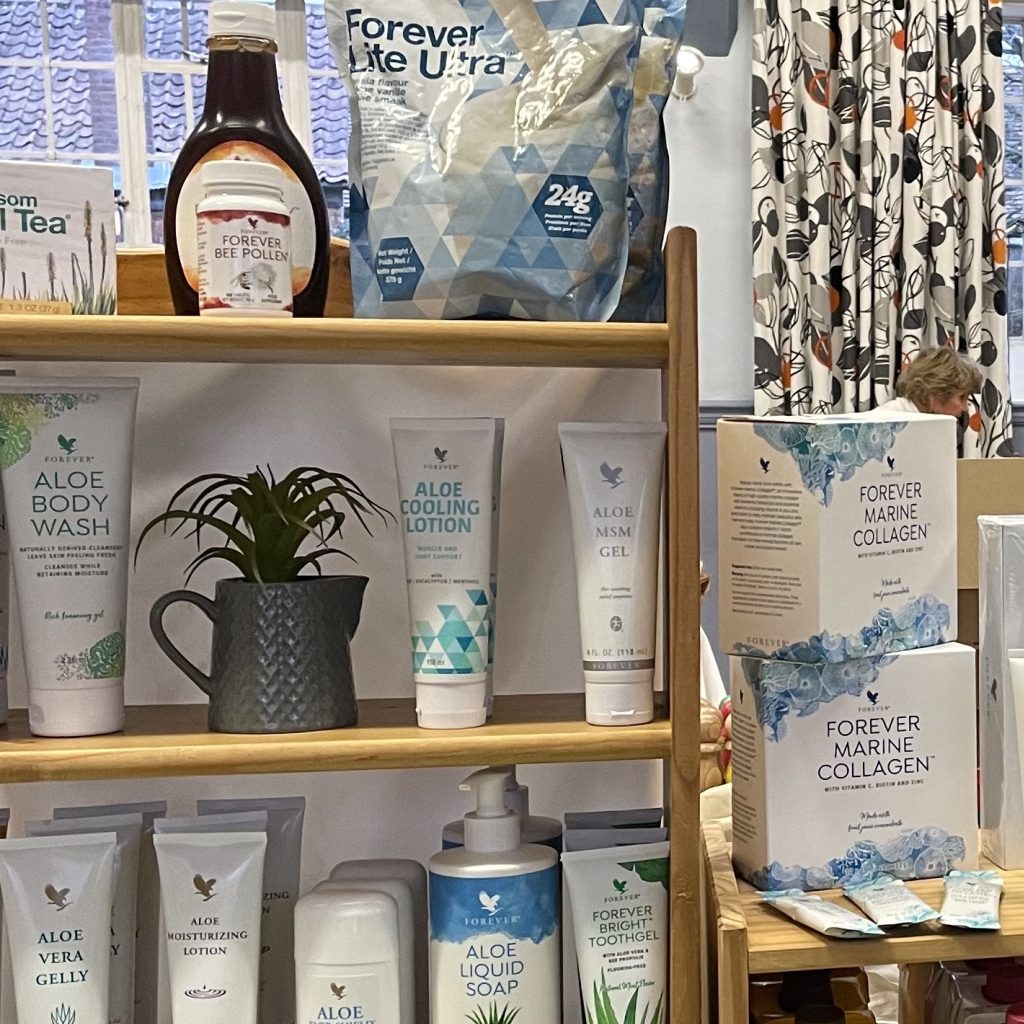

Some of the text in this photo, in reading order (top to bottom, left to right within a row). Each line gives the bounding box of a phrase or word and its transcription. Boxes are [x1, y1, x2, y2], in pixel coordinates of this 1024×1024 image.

[346, 9, 484, 48] Forever
[349, 43, 407, 73] Lite
[544, 184, 593, 214] 24g
[14, 209, 66, 234] Tea
[222, 235, 281, 249] FOREVER
[214, 247, 286, 262] BEE POLLEN
[34, 471, 104, 489] ALOE
[415, 482, 463, 497] ALOE
[860, 482, 922, 502] FOREVER
[32, 495, 108, 513] BODY
[400, 500, 480, 516] COOLING
[593, 506, 633, 518] ALOE
[864, 504, 918, 524] MARINE
[30, 519, 110, 537] WASH
[406, 518, 472, 534] LOTION
[596, 527, 632, 538] MSM
[853, 525, 927, 547] COLLAGEN
[600, 546, 629, 558] GEL
[826, 715, 921, 737] FOREVER
[834, 736, 915, 758] MARINE
[817, 756, 929, 781] COLLAGEN
[191, 917, 219, 926] ALOE
[464, 915, 518, 926] FOREVER
[593, 906, 653, 921] FOREVER
[600, 919, 648, 933] BRIGHT
[38, 929, 83, 944] ALOE
[168, 931, 248, 941] MOISTURIZING
[588, 931, 661, 947] TOOTHGEL
[38, 950, 83, 964] VERA
[183, 947, 227, 956] LOTION
[466, 943, 517, 959] ALOE
[36, 969, 89, 986] GELLY
[460, 961, 524, 979] LIQUID
[466, 979, 519, 996] SOAP
[317, 1005, 364, 1020] ALOE
